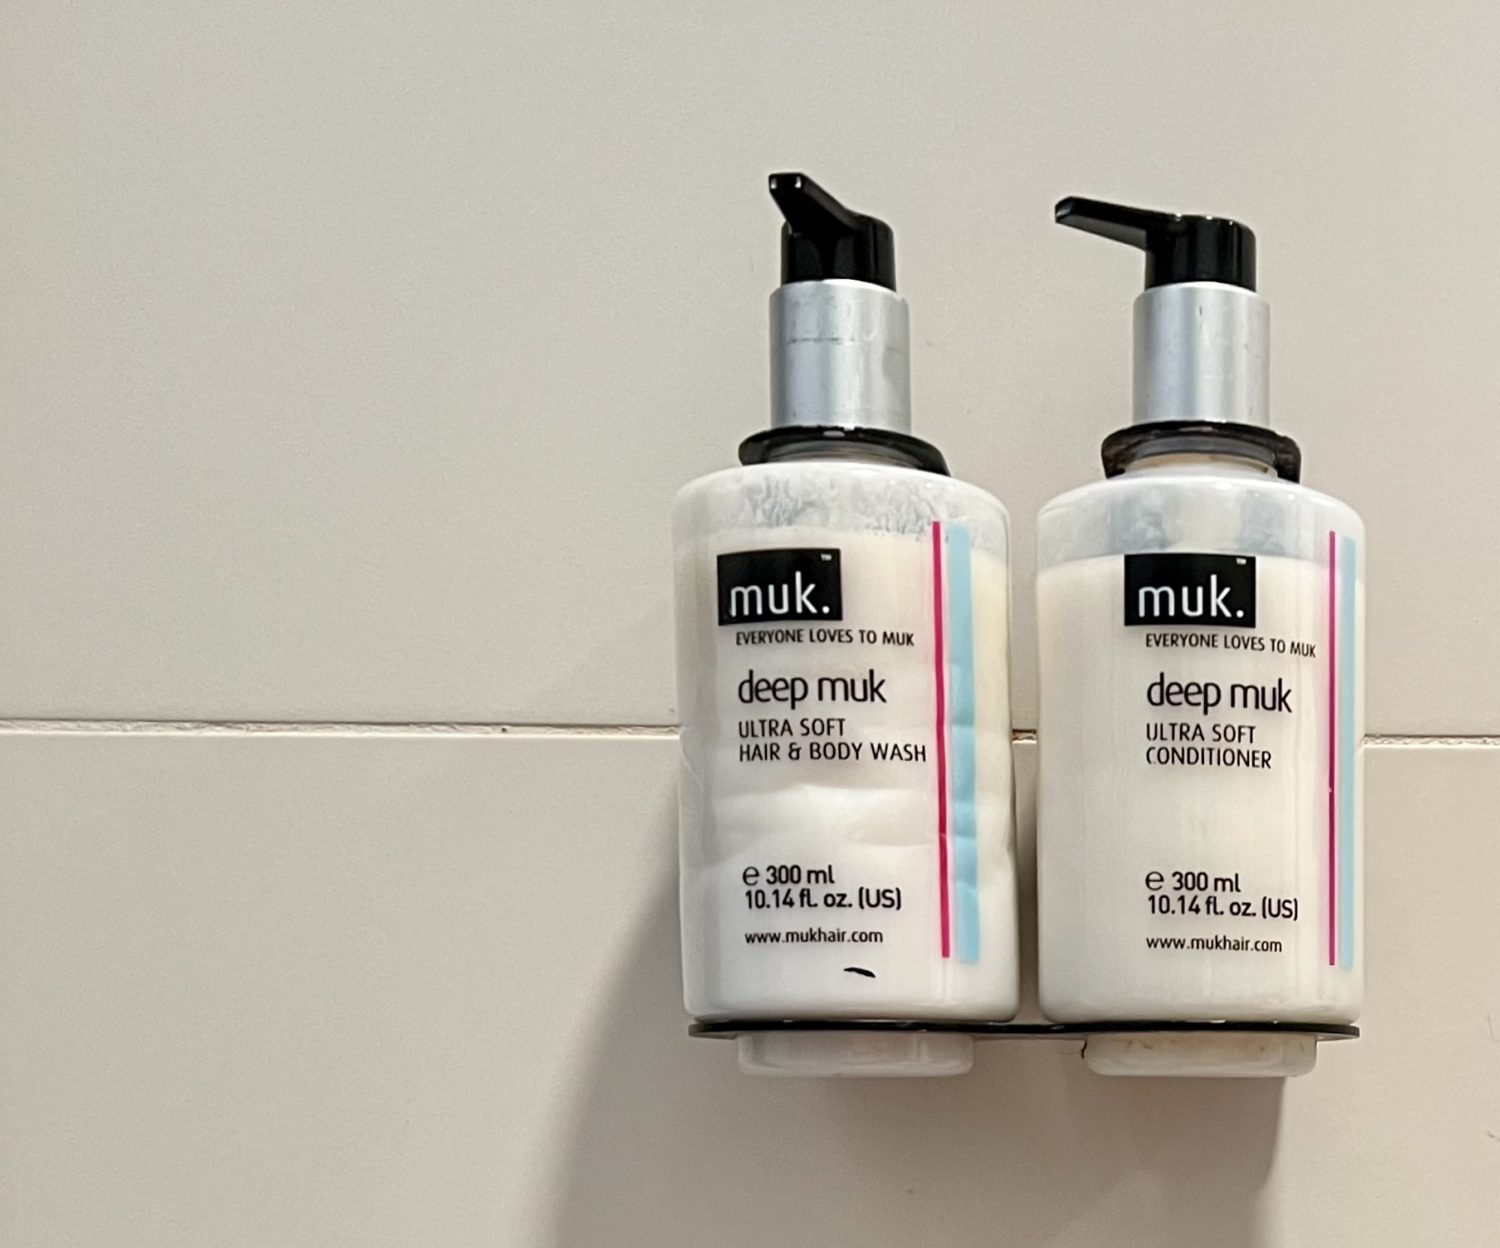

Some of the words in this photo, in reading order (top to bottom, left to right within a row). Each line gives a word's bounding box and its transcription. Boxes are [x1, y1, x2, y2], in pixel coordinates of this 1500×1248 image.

[730, 571, 830, 617] muk.
[1139, 574, 1244, 618] muk.
[736, 629, 804, 646] EVERYONE
[809, 629, 853, 643] LOVES
[859, 630, 877, 644] TO
[883, 632, 914, 646] MUK
[1146, 633, 1218, 648] EVERYONE
[1224, 635, 1265, 651] LOVES
[1270, 638, 1286, 653] TO
[1290, 641, 1316, 658] MUK
[738, 669, 808, 710] deep
[818, 669, 887, 703] muk
[1147, 672, 1221, 716] deep
[1230, 678, 1292, 713] muk
[738, 719, 793, 738] ULTRA
[801, 718, 845, 736] SOFT
[1146, 723, 1205, 742] ULTRA
[1212, 724, 1256, 744] SOFT
[739, 743, 780, 762] HAIR
[788, 743, 801, 761] &
[809, 743, 863, 760] BODY
[871, 743, 927, 762] WASH
[1146, 747, 1272, 769] CONDITIONER
[766, 865, 801, 884] 300
[807, 864, 835, 884] ml
[1172, 871, 1209, 892] 300
[1214, 873, 1241, 893] ml
[745, 888, 795, 910] 10.14
[800, 888, 818, 908] fl.
[823, 891, 852, 908] oz.
[858, 886, 902, 911] (US)
[1148, 895, 1201, 915] 10.14
[1205, 895, 1224, 916] fl.
[1229, 901, 1256, 917] oz.
[1261, 896, 1299, 921] (US)
[744, 928, 883, 944] www.mukhair.com
[1146, 935, 1282, 953] www.mukhair.com
